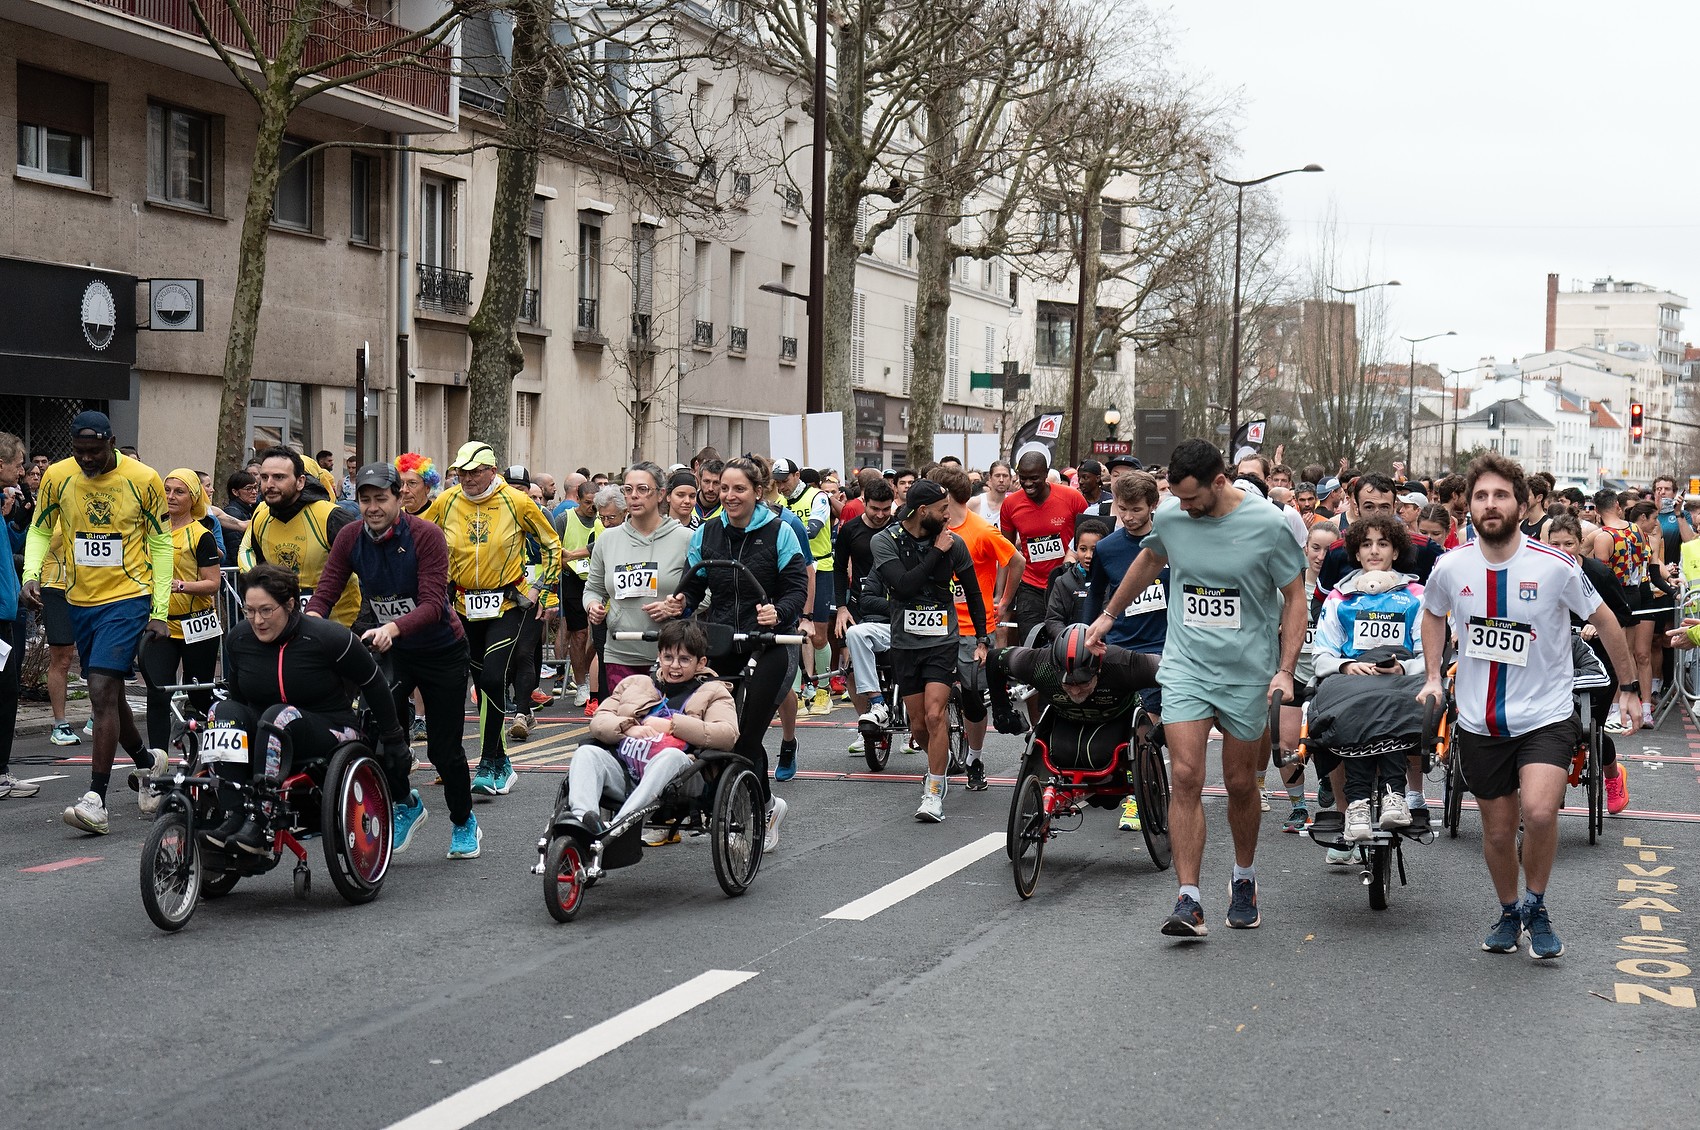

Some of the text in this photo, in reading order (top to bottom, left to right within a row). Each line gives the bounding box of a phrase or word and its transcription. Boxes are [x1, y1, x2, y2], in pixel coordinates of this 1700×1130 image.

[84, 541, 111, 557] 185
[1030, 541, 1061, 555] 3048
[617, 571, 653, 589] 3037
[374, 600, 411, 616] 2145
[468, 595, 500, 610] 1093
[1187, 596, 1235, 617] 3035
[186, 615, 217, 635] 1098
[908, 612, 943, 627] 3263
[1359, 621, 1400, 639] 2086
[1472, 627, 1524, 653] 3050
[203, 731, 242, 750] 2146
[620, 736, 652, 764] GIRL
[1615, 836, 1697, 1009] LIVRAISON
